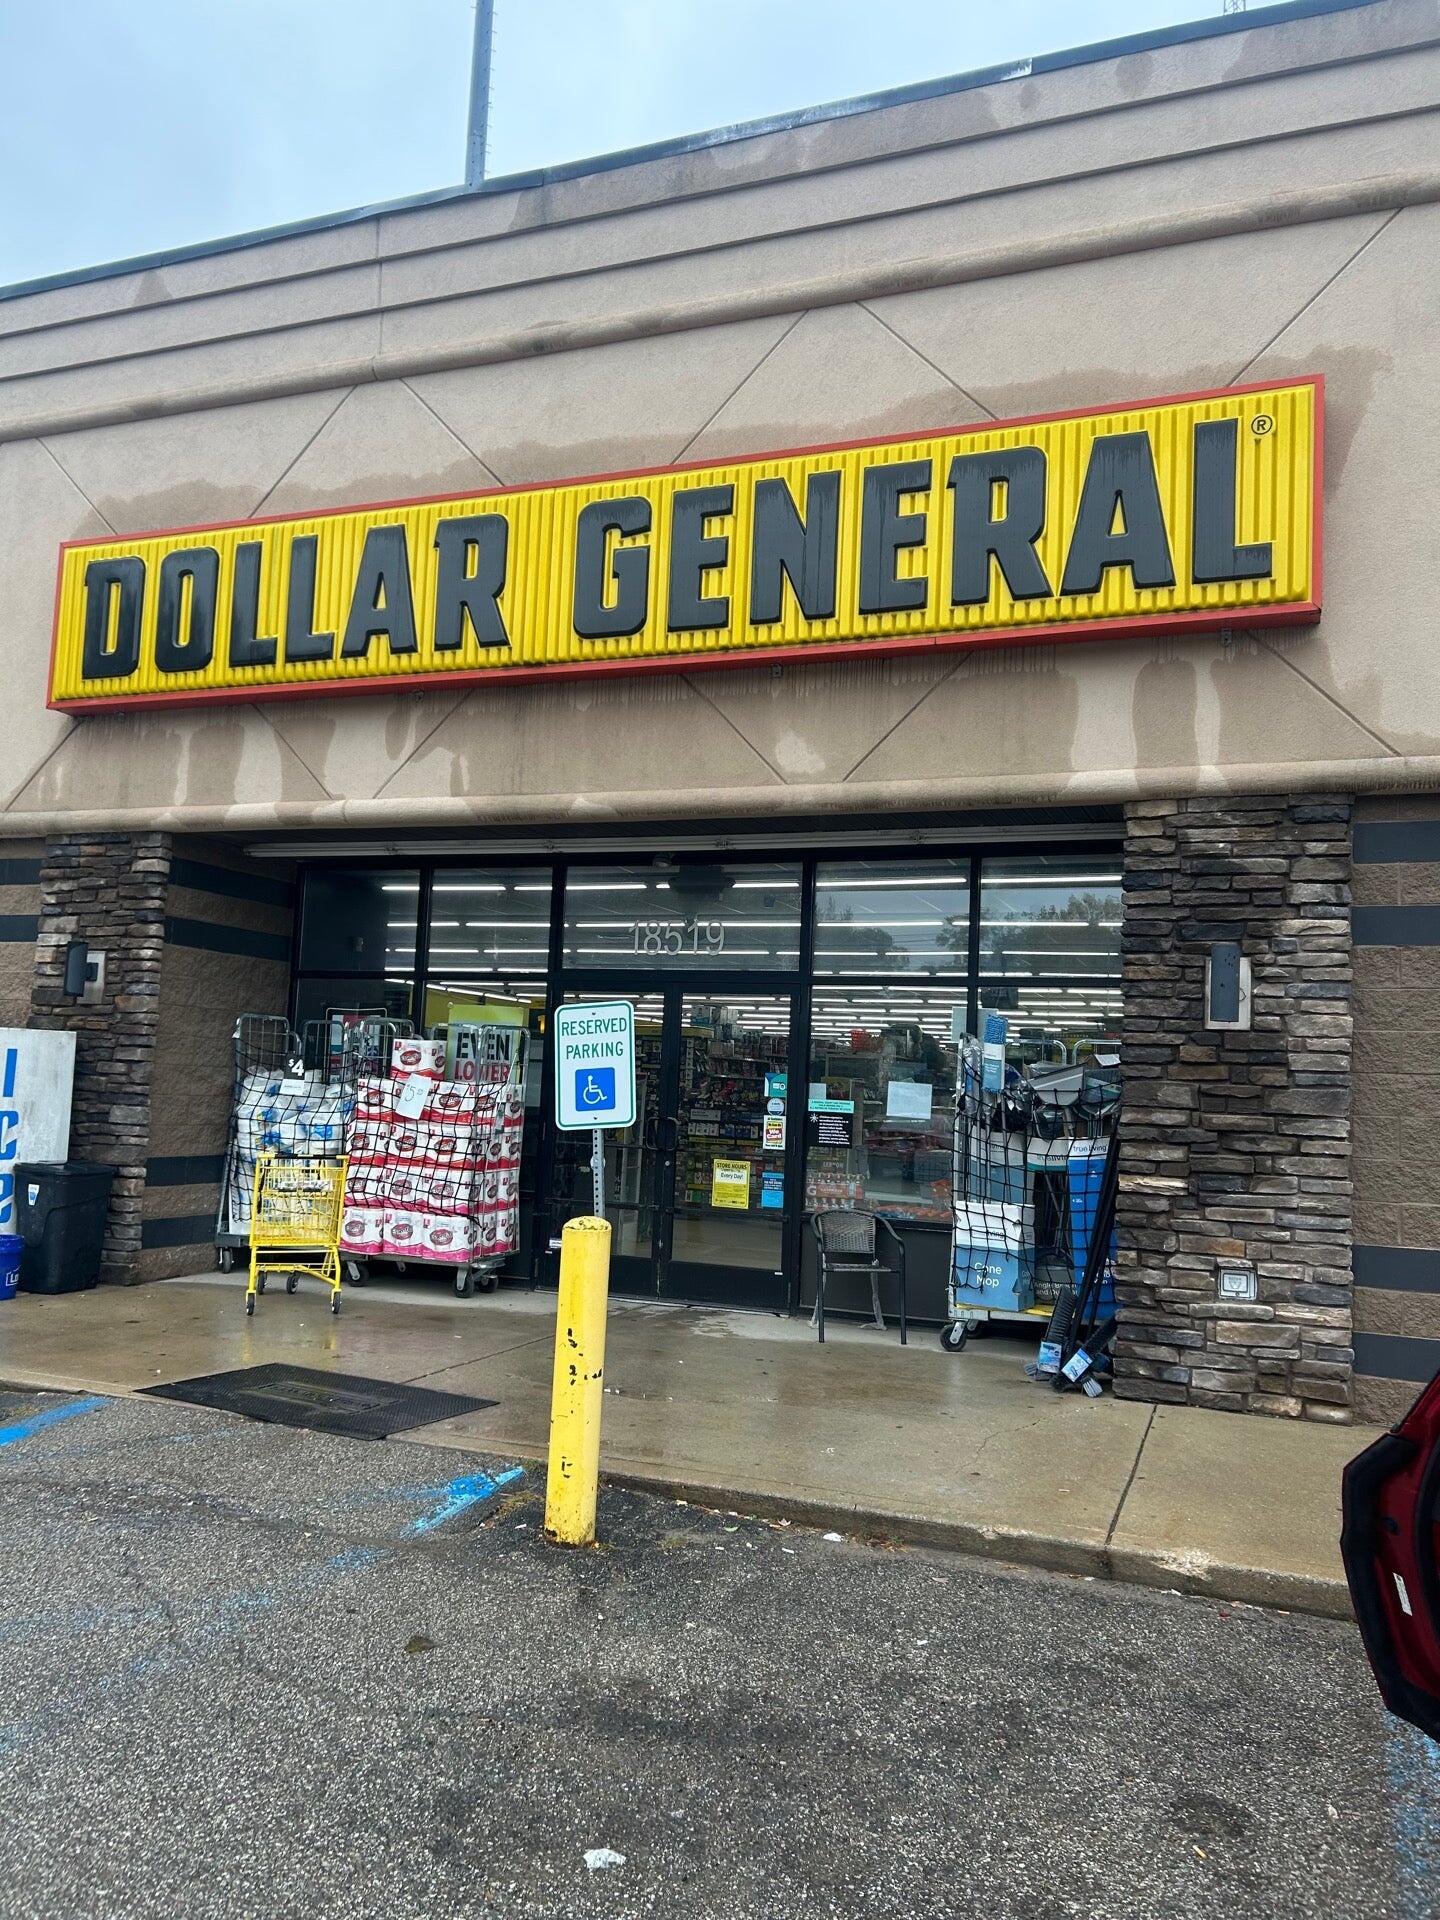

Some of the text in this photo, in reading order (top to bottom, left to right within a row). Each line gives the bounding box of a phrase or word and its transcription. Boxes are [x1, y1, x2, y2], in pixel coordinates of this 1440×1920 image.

[81, 513, 510, 680] DOLLAR
[573, 418, 1273, 640] GENERAL
[629, 919, 725, 956] 18519
[561, 1017, 628, 1036] RESERVED
[456, 1032, 510, 1061] EVEN
[566, 1041, 624, 1060] PARKING
[288, 1058, 305, 1077] $4
[974, 1262, 1002, 1275] Cone
[976, 1274, 1000, 1288] Mop
